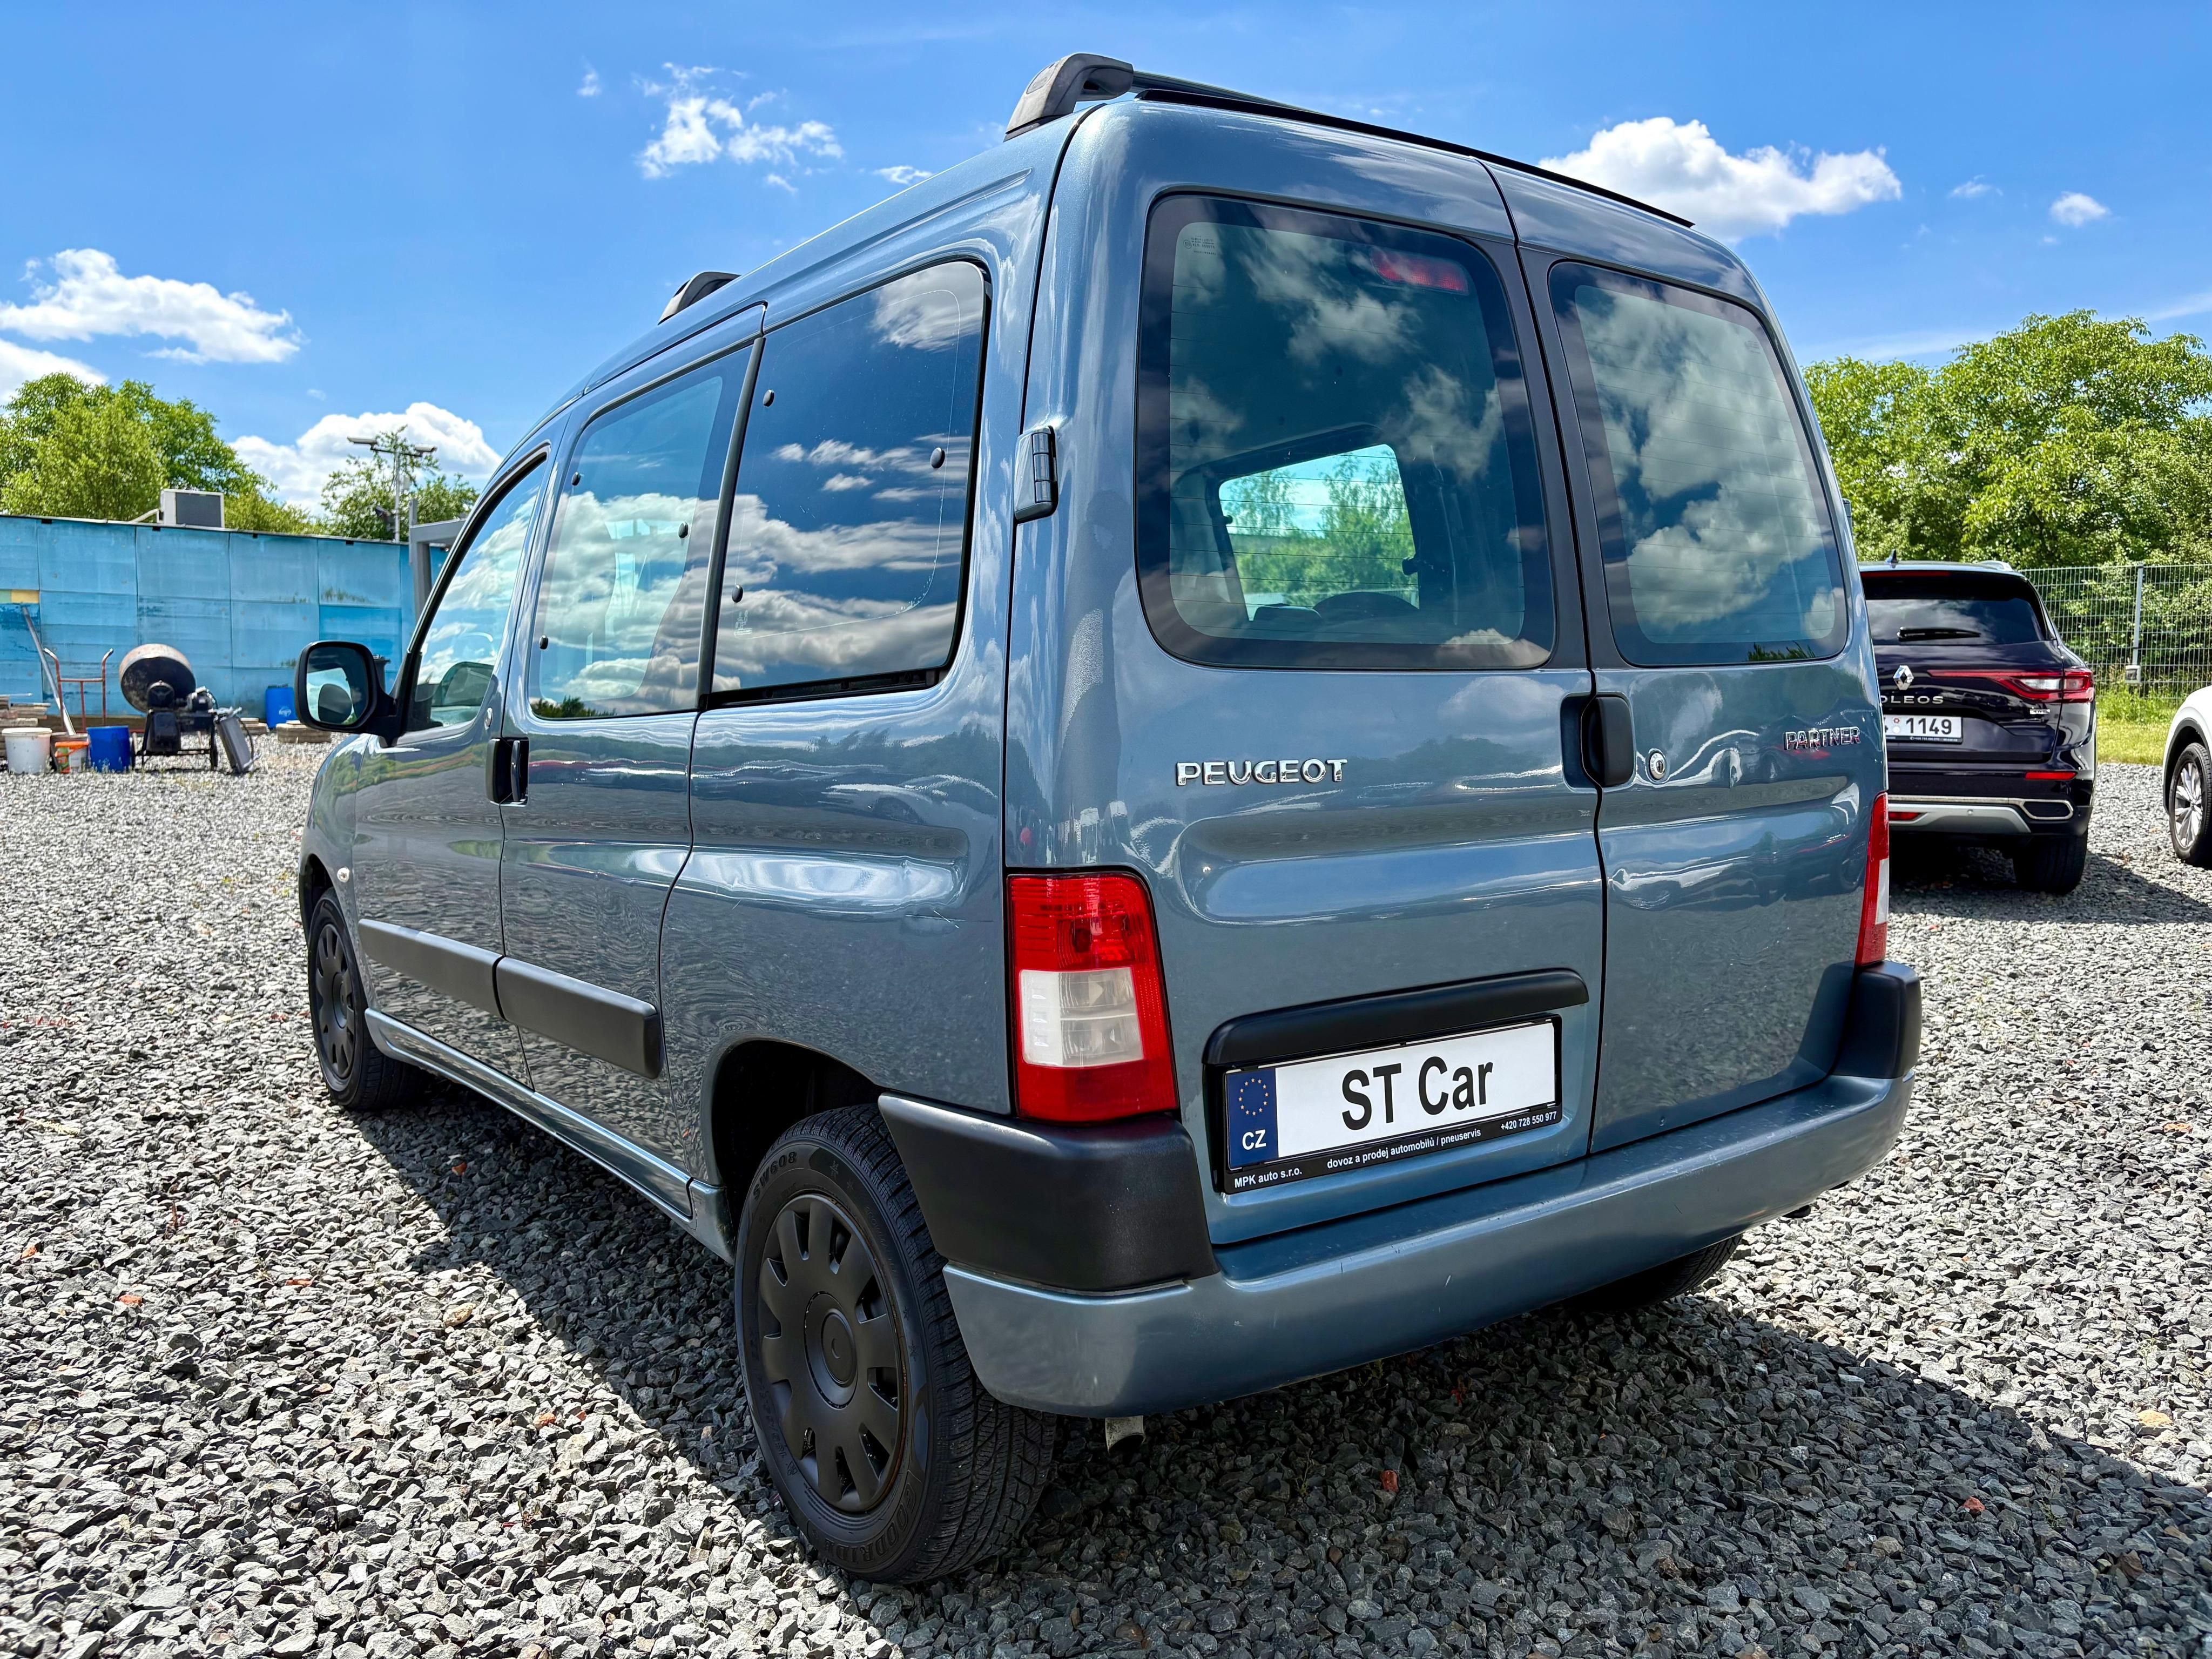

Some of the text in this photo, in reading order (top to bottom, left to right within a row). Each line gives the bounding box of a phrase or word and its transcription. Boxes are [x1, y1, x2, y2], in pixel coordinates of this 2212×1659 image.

[1784, 726, 1861, 751] PARTNER
[1906, 717, 1952, 735] 1149
[1175, 758, 1348, 786] PEUGEOT
[1341, 1056, 1493, 1130] ST Car
[1500, 1111, 1557, 1130] +420 728 550 977
[1242, 1129, 1266, 1150] CZ
[1327, 1156, 1353, 1169] dovoz
[1362, 1148, 1388, 1164] prodej
[1391, 1137, 1434, 1155] automobilů
[1435, 1137, 1439, 1145] /
[1441, 1128, 1481, 1147] pneuservis
[753, 1151, 797, 1201] SW608
[1235, 1168, 1302, 1188] MPK auto s.r.o.
[824, 1482, 916, 1564] GOODRIDE
